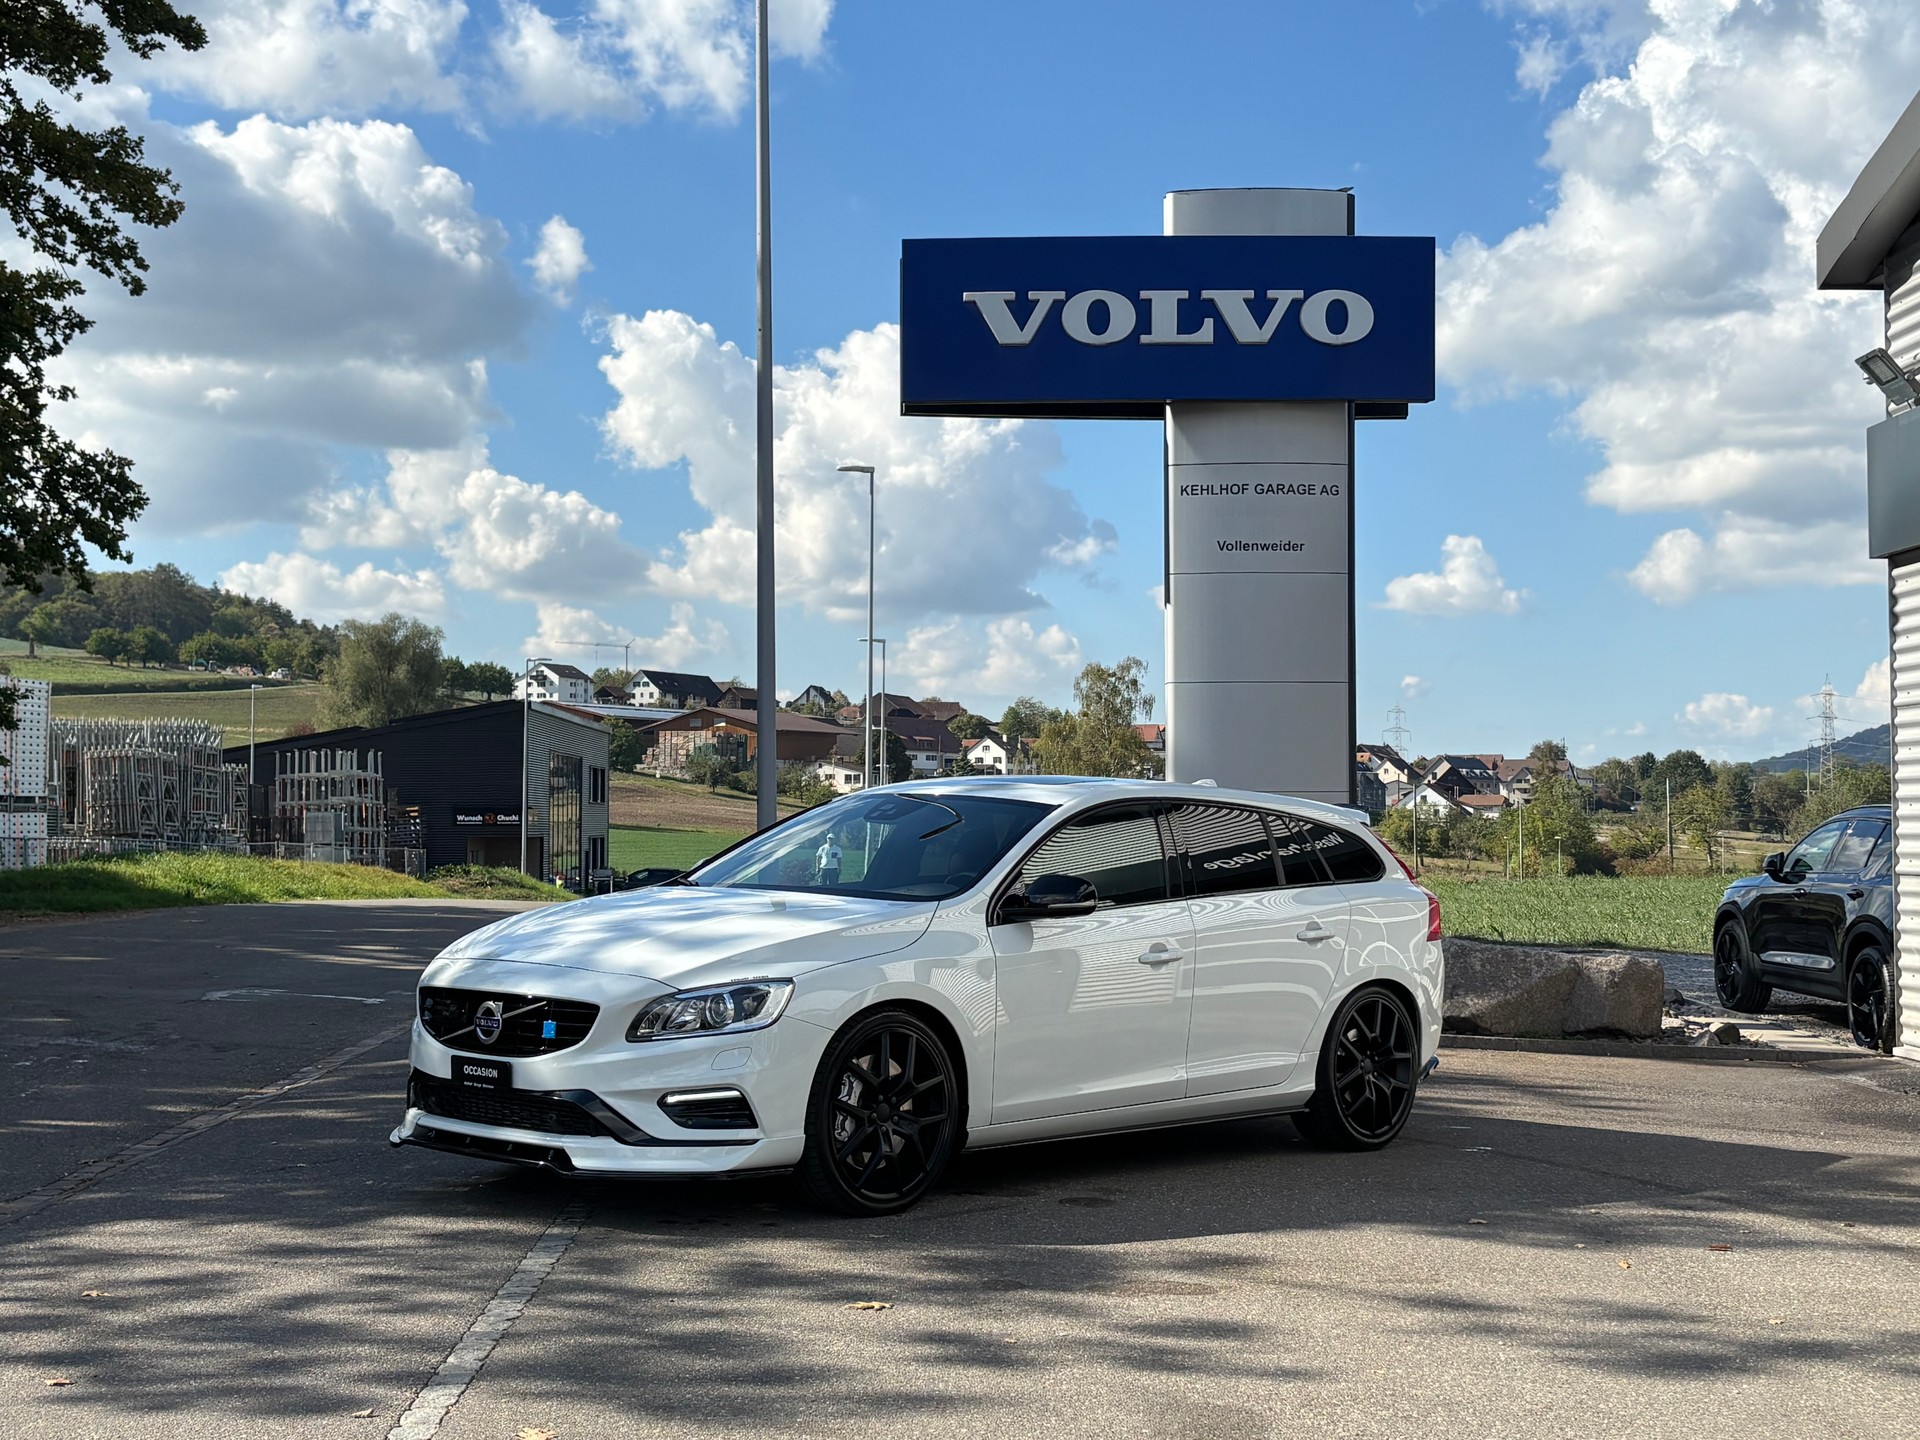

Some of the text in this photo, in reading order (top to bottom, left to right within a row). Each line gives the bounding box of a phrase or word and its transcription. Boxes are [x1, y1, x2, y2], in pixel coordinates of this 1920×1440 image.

[963, 289, 1375, 346] VOLVO
[1180, 483, 1340, 496] KEHLHOF GARAGE AG
[1217, 540, 1306, 552] Vollenweider
[476, 1018, 499, 1027] VOLVO
[463, 1065, 498, 1078] OCCASION
